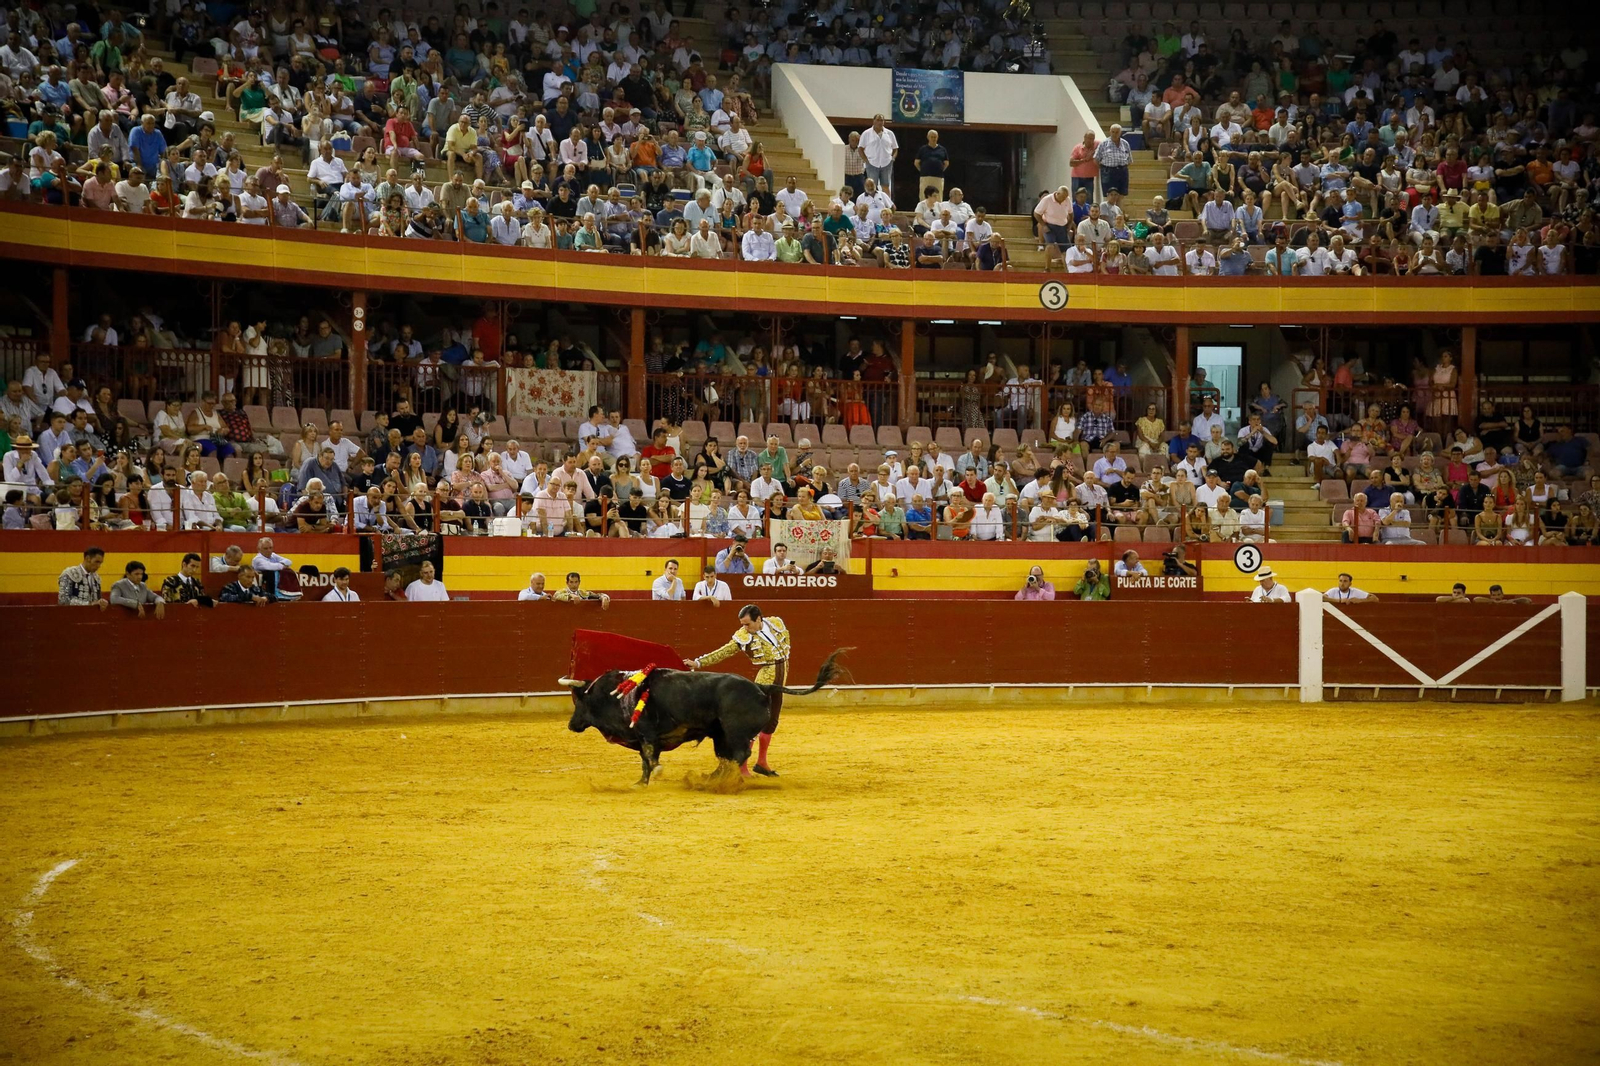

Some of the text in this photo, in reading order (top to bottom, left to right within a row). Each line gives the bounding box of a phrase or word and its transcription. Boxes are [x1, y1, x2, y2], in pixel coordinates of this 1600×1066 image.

[1048, 286, 1061, 305] 3
[1242, 550, 1254, 568] 3
[743, 575, 837, 587] GANADEROS
[1117, 577, 1197, 588] PUERTA DE CORTE
